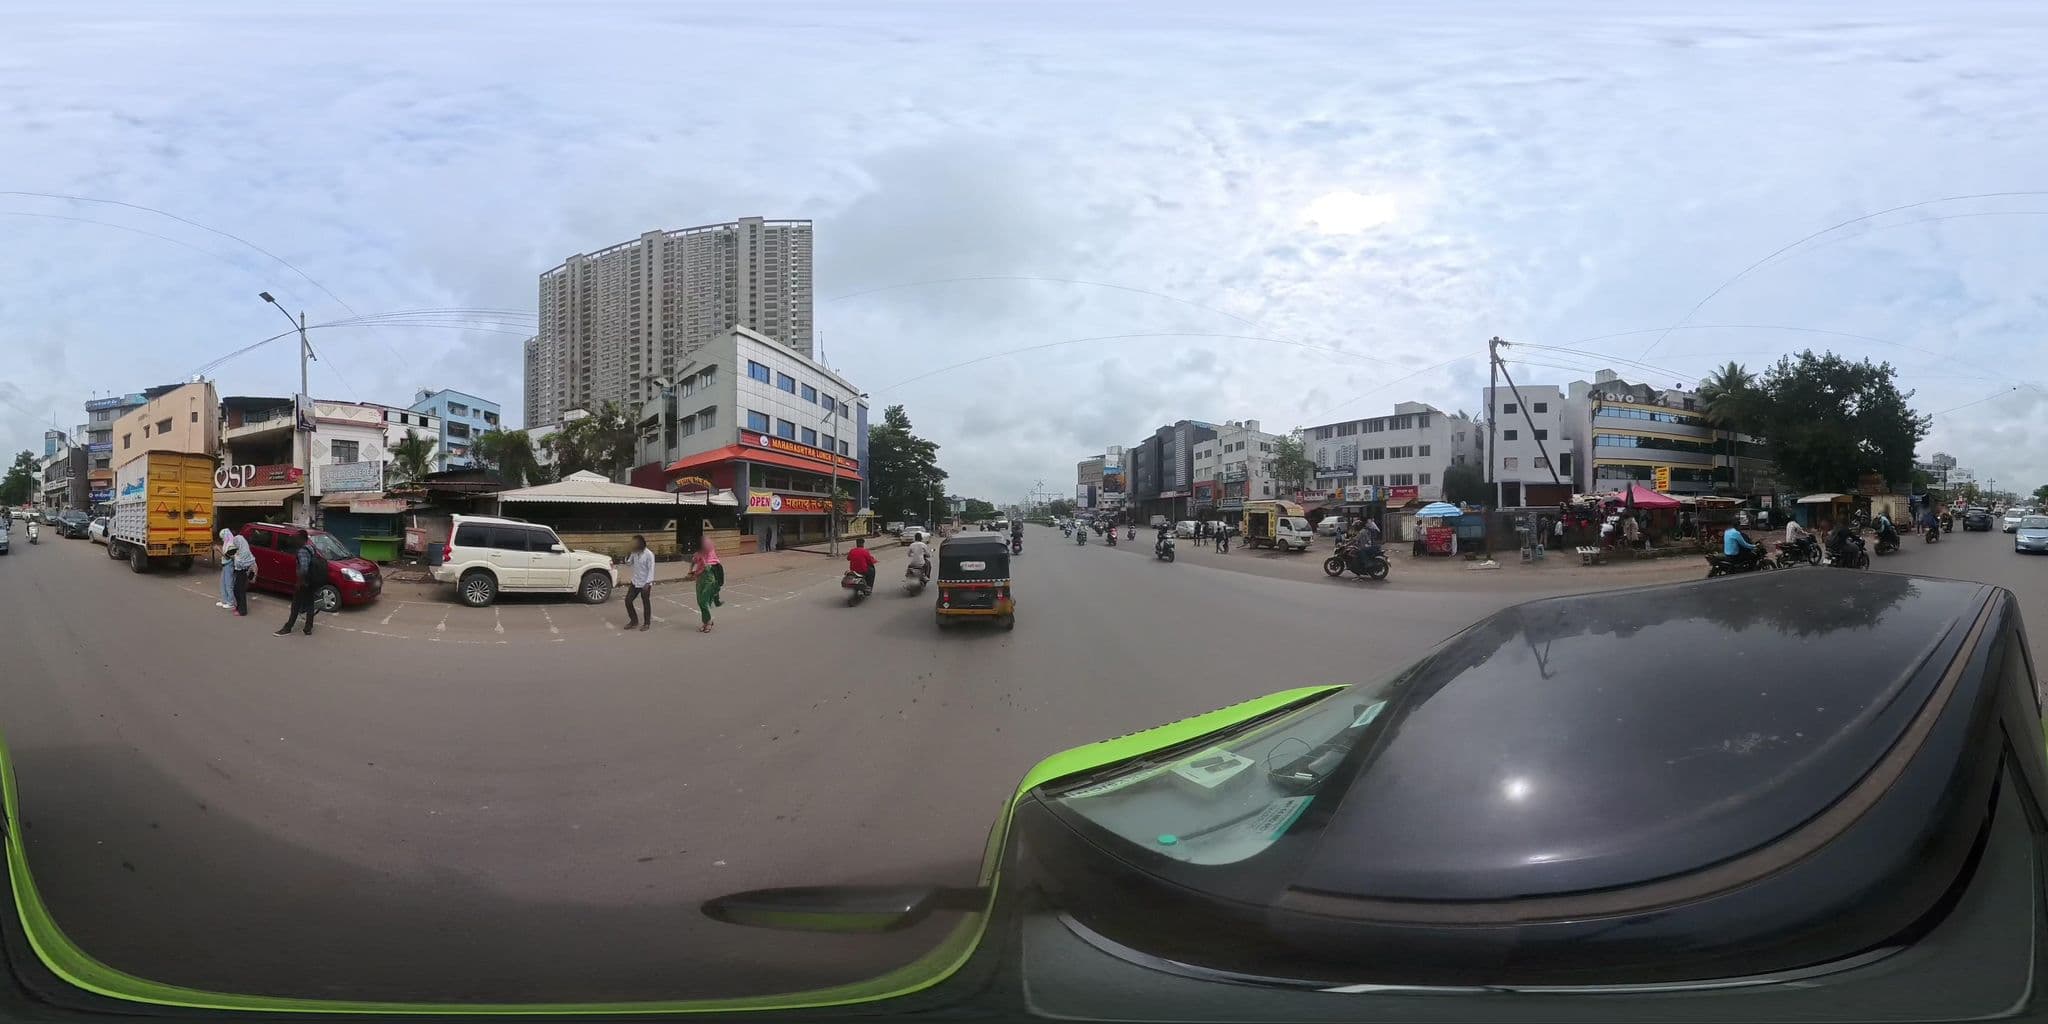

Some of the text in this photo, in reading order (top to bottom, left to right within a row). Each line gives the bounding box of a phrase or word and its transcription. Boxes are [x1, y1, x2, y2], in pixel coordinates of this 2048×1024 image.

[1606, 393, 1634, 403] OYO
[772, 439, 816, 458] MAHARASHTRA
[816, 450, 832, 461] LUNCH
[214, 464, 256, 488] OSP
[750, 496, 769, 507] OPEN
